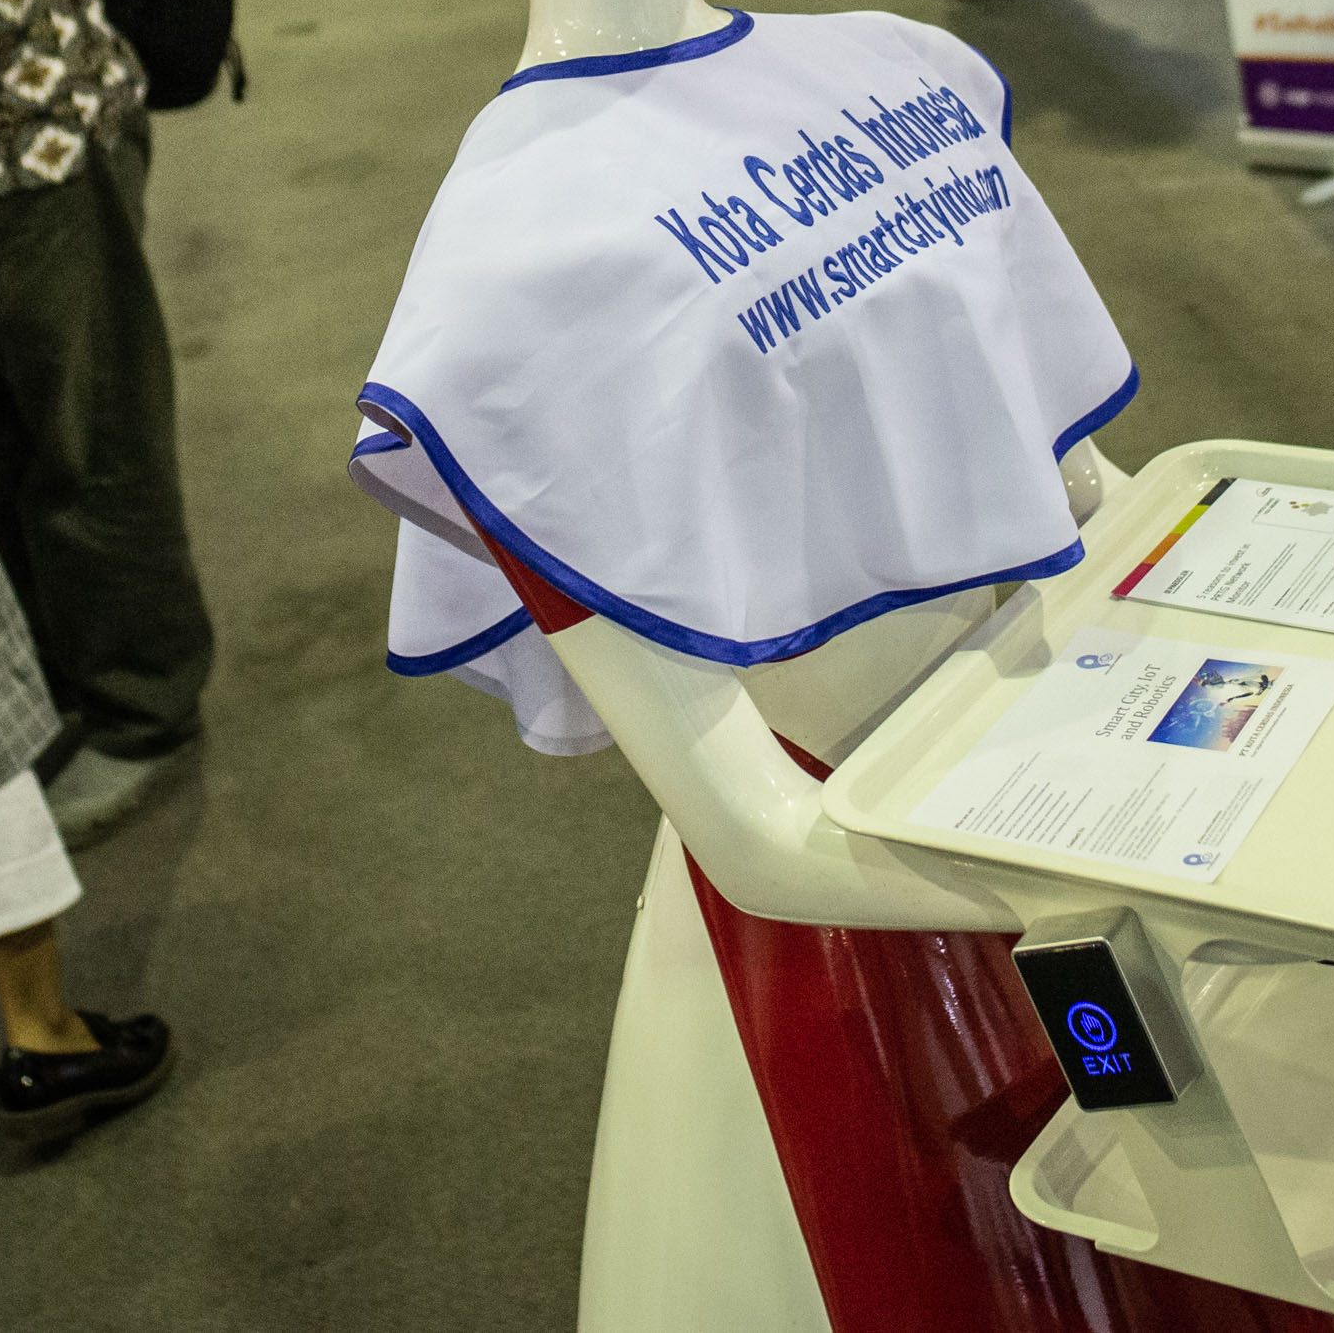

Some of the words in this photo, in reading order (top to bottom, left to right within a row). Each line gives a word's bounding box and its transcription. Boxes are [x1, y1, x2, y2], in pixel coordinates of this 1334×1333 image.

[654, 190, 784, 285] Kota
[743, 129, 884, 228] Cerdas
[840, 76, 987, 170] Indonesia
[1095, 706, 1130, 737] Smart
[1121, 684, 1149, 705] City,
[1137, 663, 1161, 681] IoT
[1121, 720, 1143, 740] and
[1133, 675, 1177, 718] Robotics
[1082, 1052, 1132, 1076] EXIT
